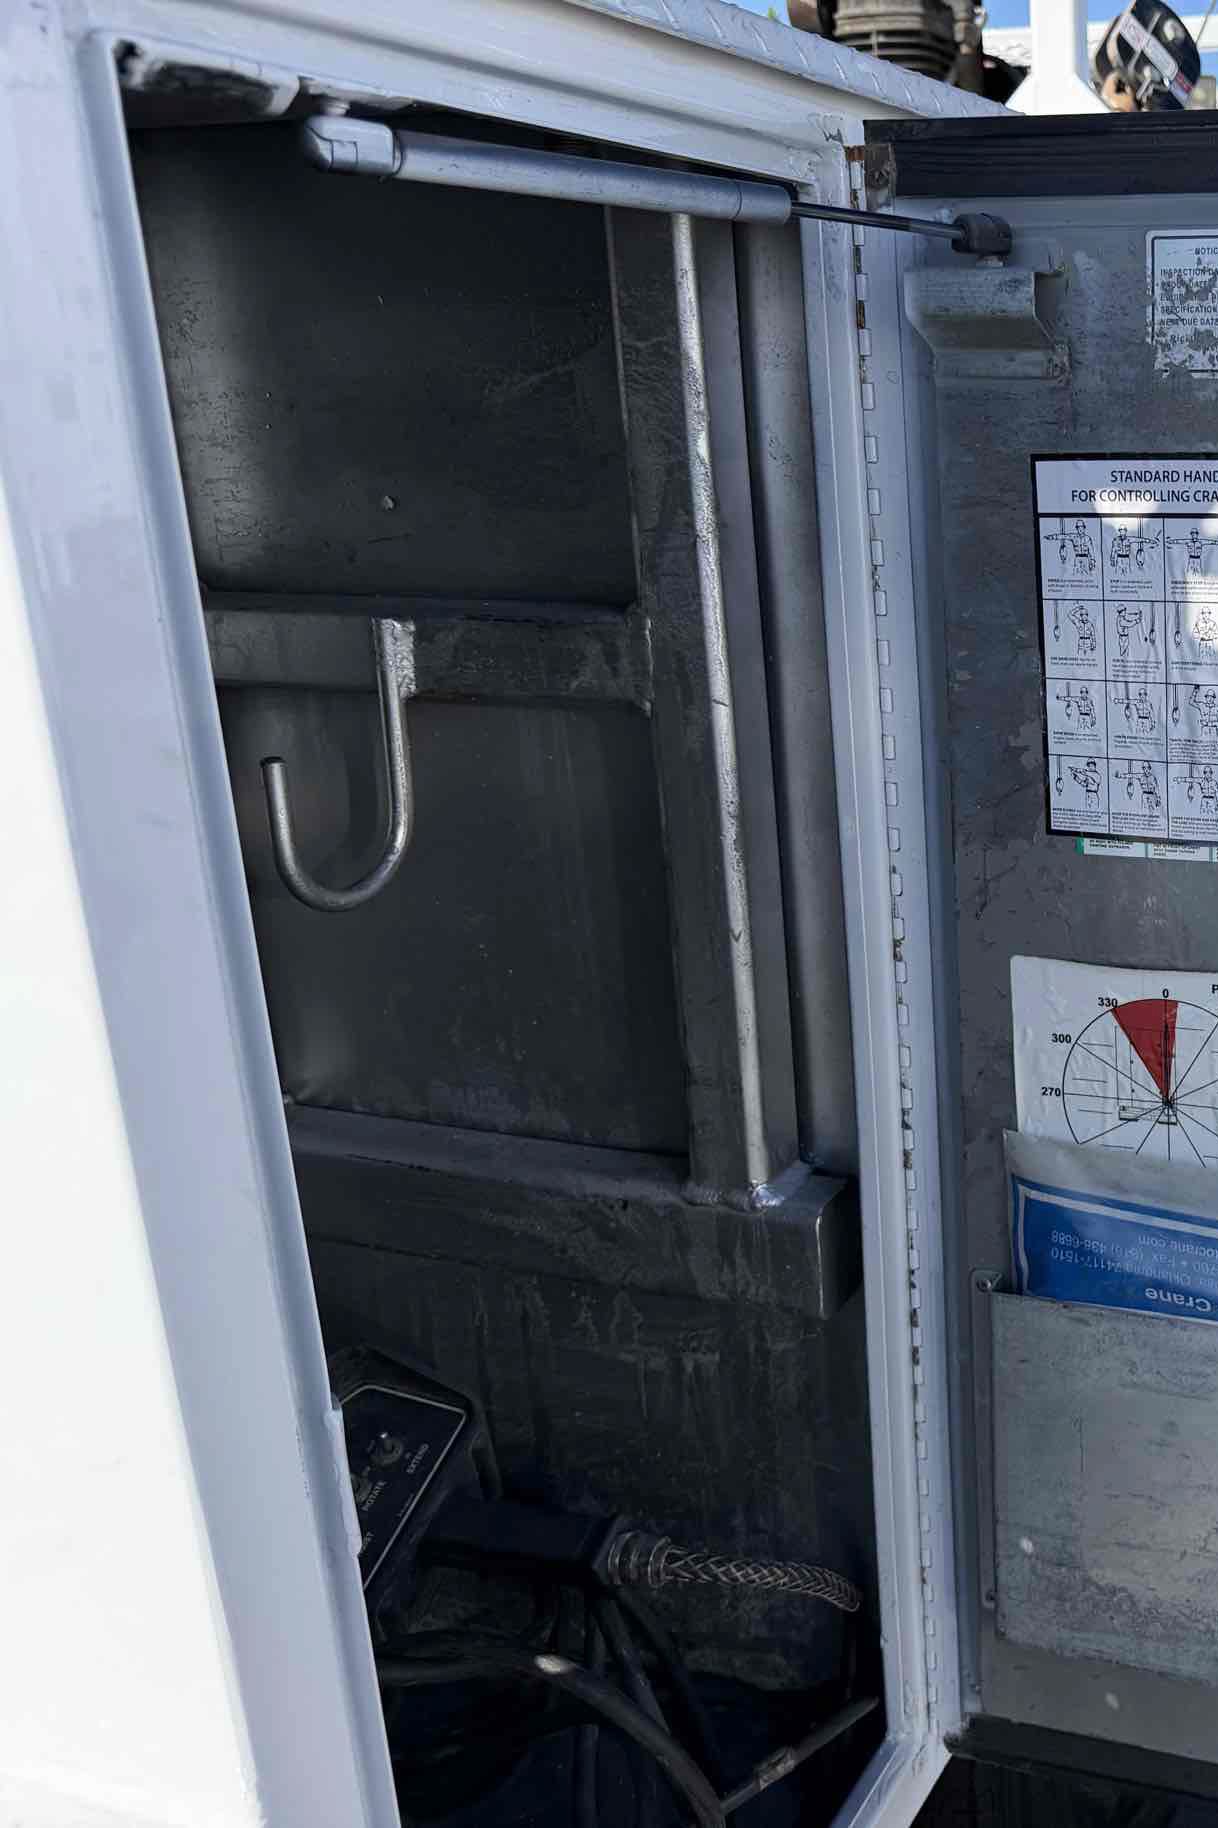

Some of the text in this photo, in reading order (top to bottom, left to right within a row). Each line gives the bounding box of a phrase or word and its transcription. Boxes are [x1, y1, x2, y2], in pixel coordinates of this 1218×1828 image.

[1182, 318, 1198, 326] DUE
[1110, 470, 1180, 484] STANDARD
[1071, 489, 1097, 502] FOR
[1099, 488, 1191, 503] CONTROLLING
[1162, 988, 1169, 999] 0
[1097, 997, 1118, 1008] 330
[1051, 1033, 1072, 1044] 300
[1041, 1086, 1061, 1097] 270
[1144, 1287, 1211, 1313] Crane
